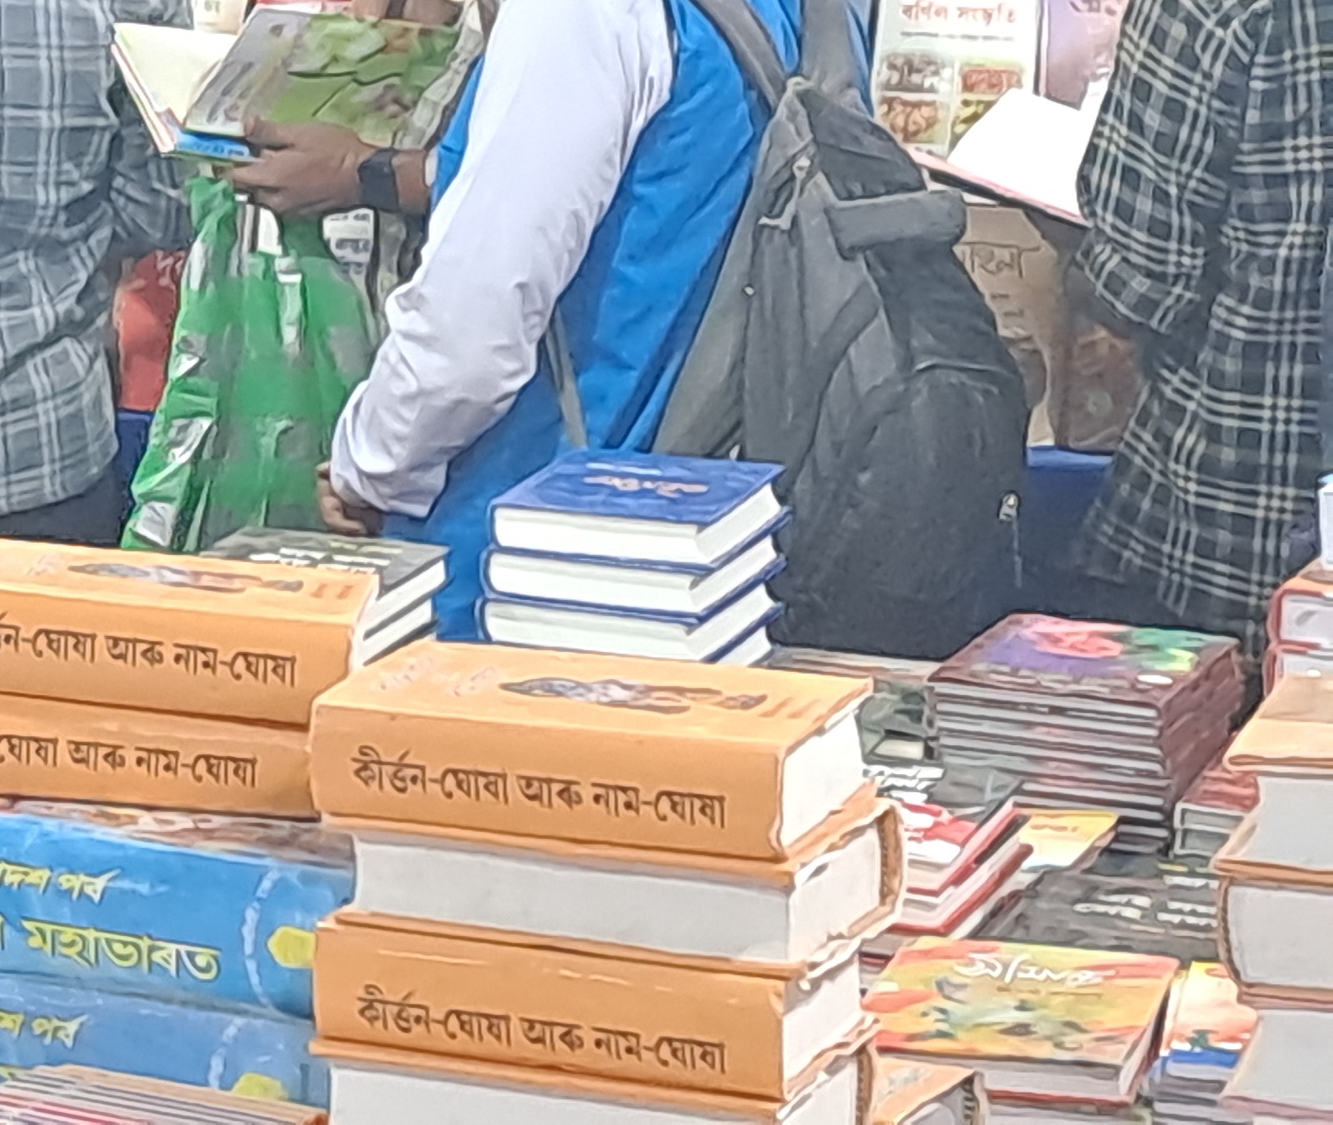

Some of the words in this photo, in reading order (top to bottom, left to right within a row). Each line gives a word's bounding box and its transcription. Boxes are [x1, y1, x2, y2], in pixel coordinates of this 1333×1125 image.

[104, 634, 165, 668] আৰু
[172, 642, 297, 688] নাম-ঘোষা
[66, 739, 127, 772] আৰু
[134, 746, 258, 788] নাম-ঘোষা
[515, 773, 585, 810] আৰু
[590, 781, 727, 829] নাম-ঘোষা
[20, 916, 223, 982] মহাভাৰত
[518, 1016, 585, 1052] আৰু
[591, 1025, 727, 1074] নাম-ঘোষা
